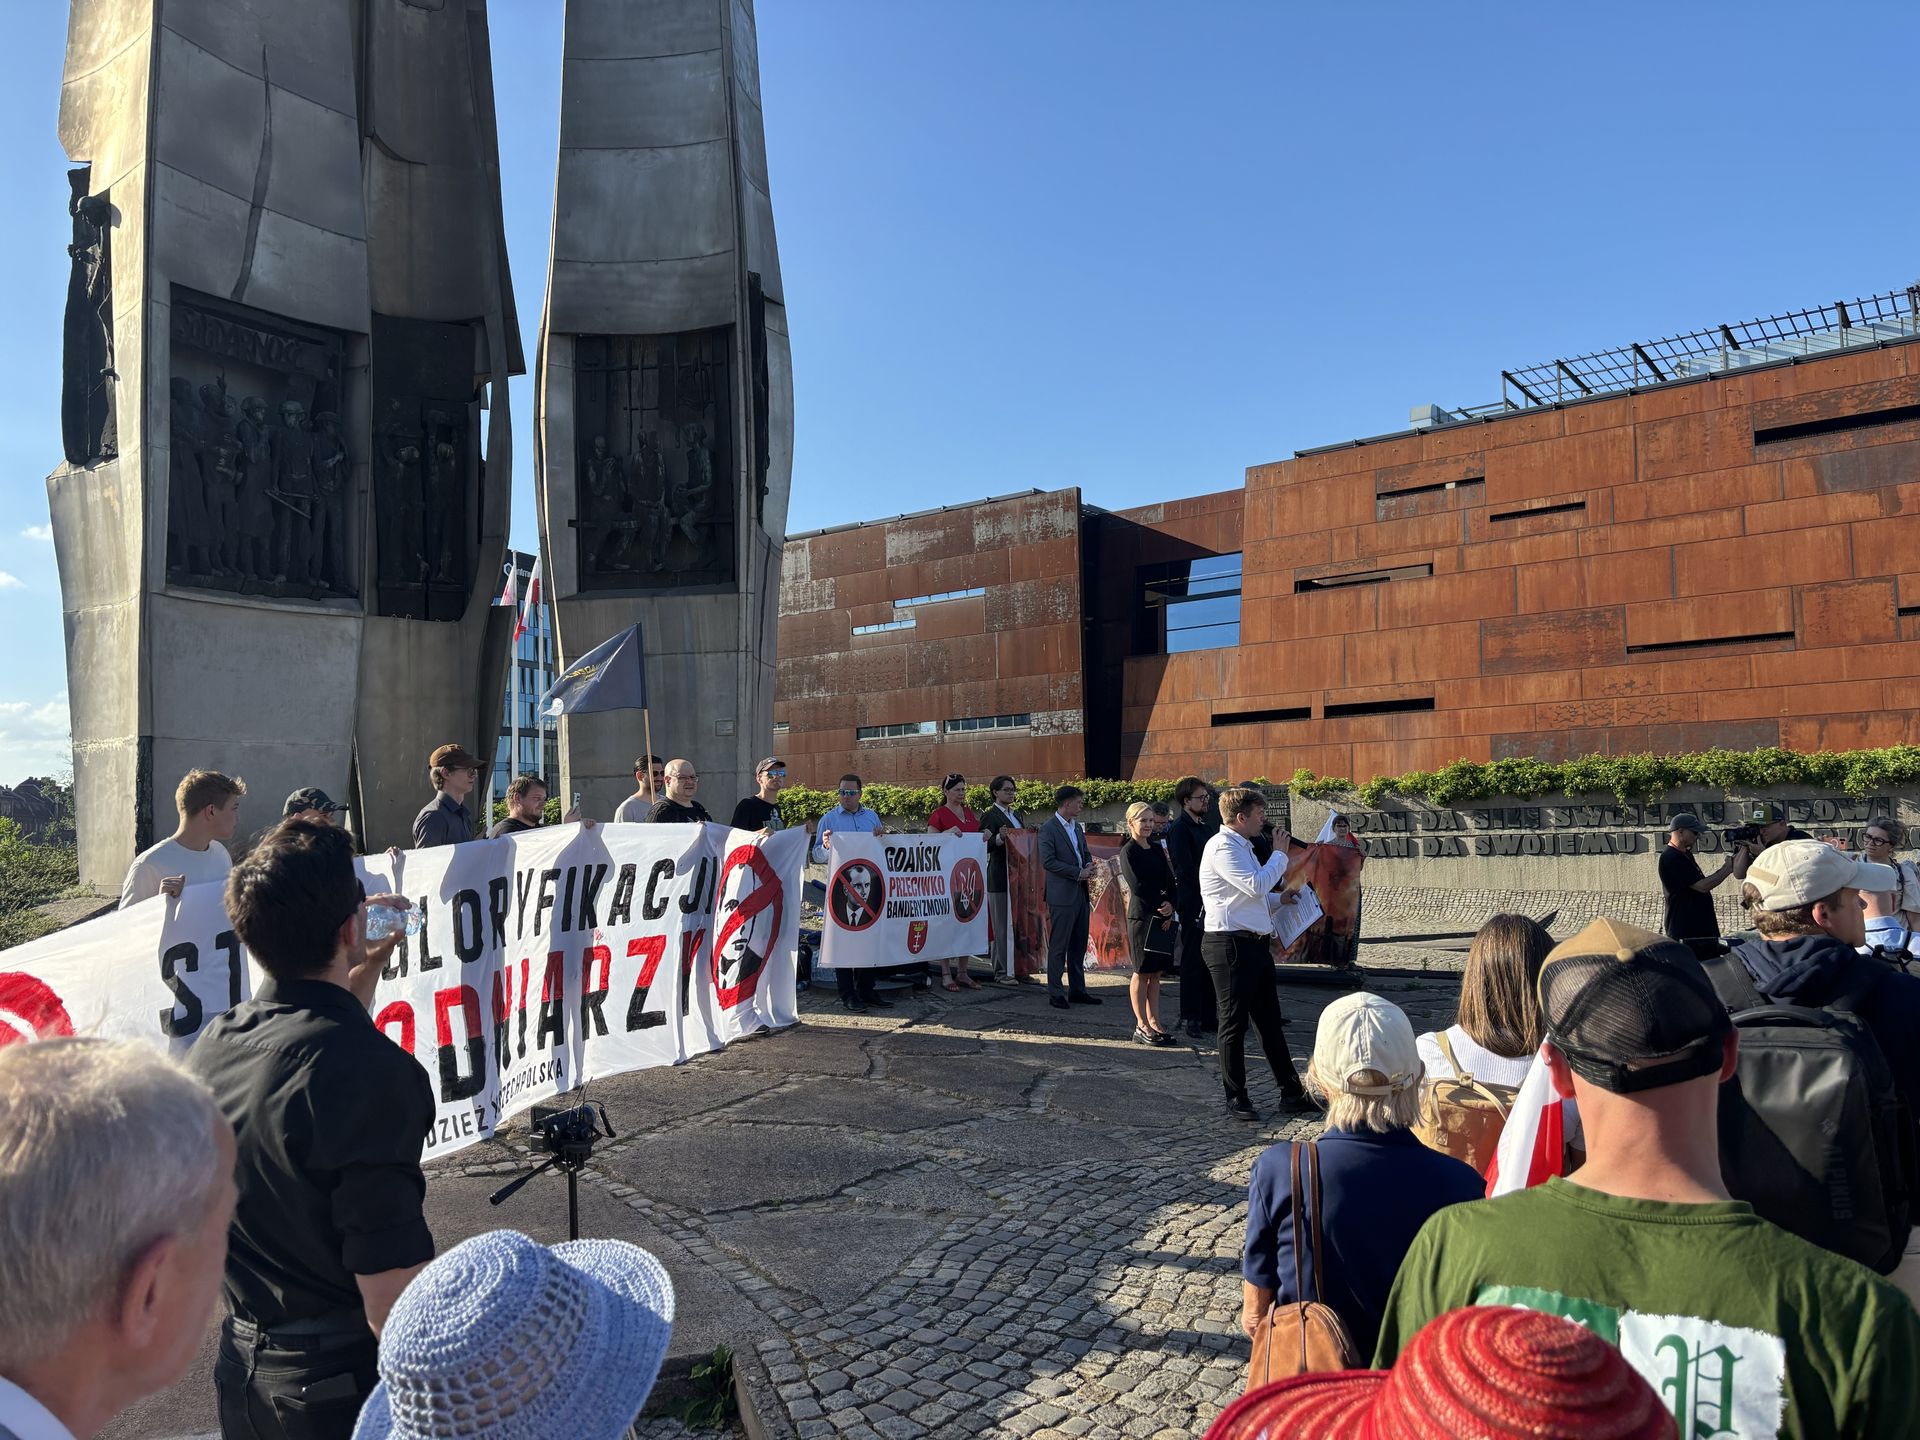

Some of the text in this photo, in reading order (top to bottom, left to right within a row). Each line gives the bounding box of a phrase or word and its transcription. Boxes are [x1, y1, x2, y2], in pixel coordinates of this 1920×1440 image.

[1350, 811, 1407, 831] PAN
[1421, 810, 1458, 830] DA
[1423, 836, 1459, 856] DA
[1475, 832, 1636, 855] SWOJEMU
[885, 841, 941, 872] GDAŃSK
[889, 875, 945, 897] PRZECIWKO
[886, 898, 950, 919] BANDERYZMOWI
[426, 1104, 488, 1148] DZIEŻ
[1823, 1143, 1853, 1220] ALPINUS
